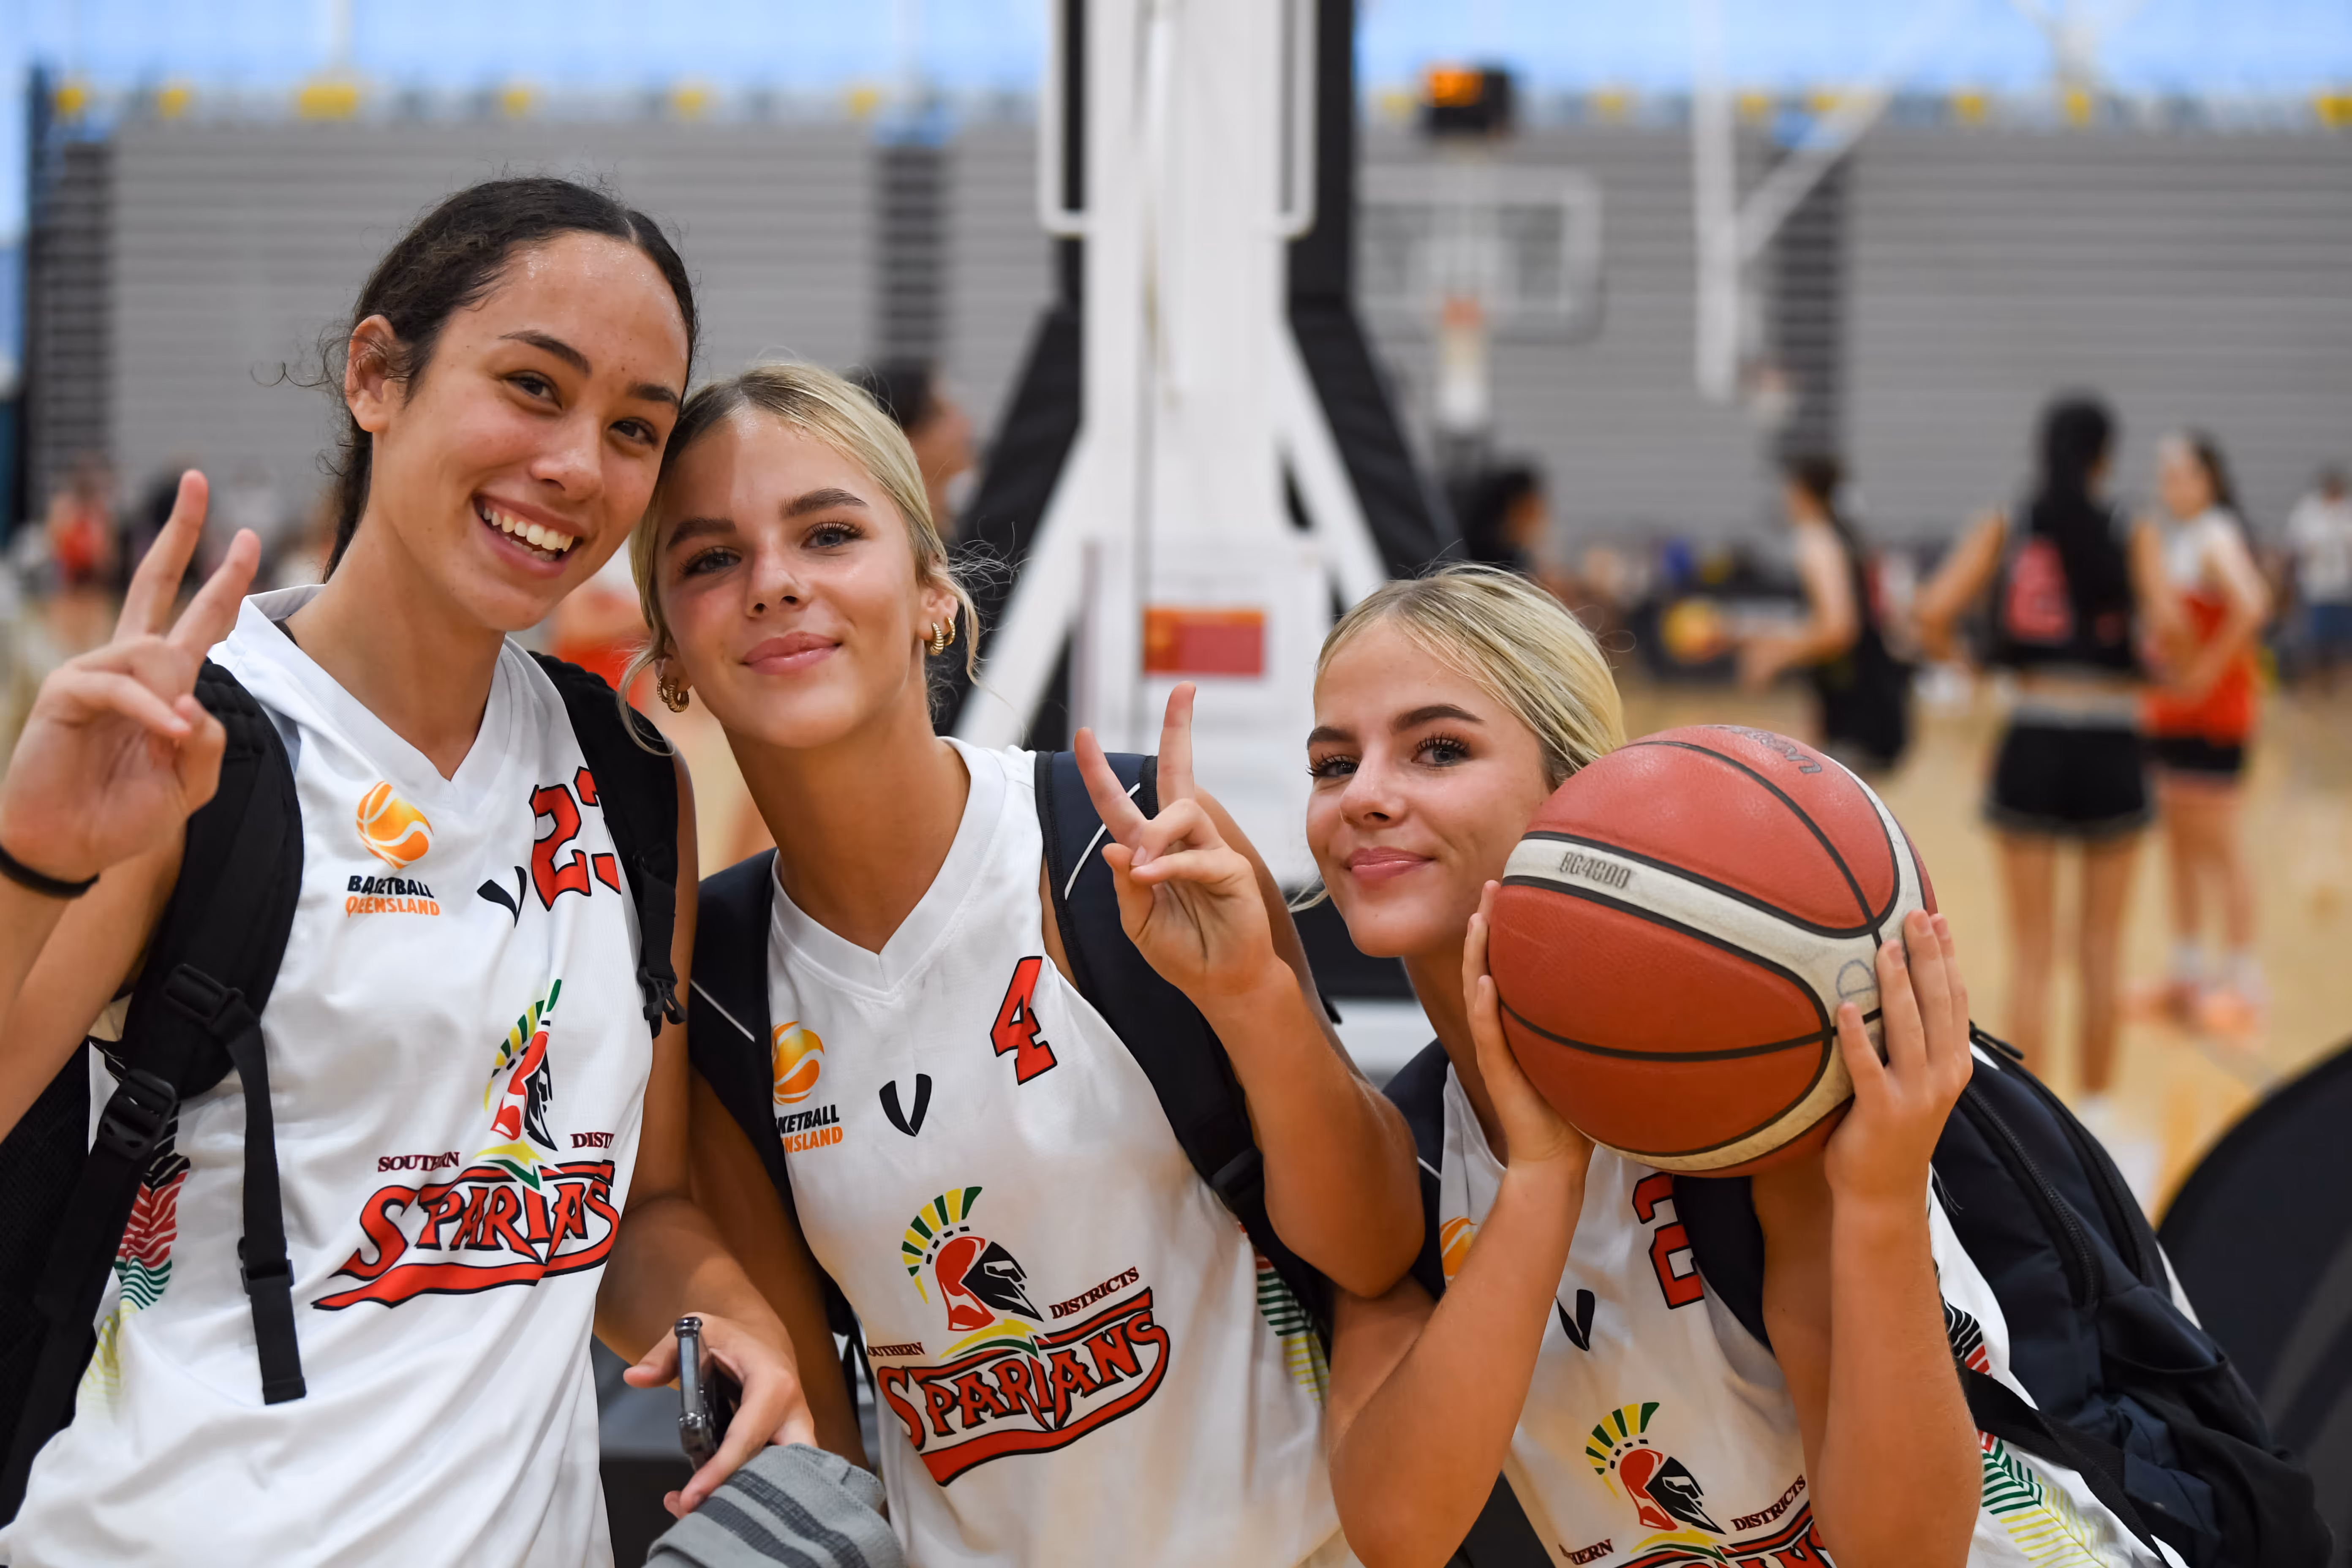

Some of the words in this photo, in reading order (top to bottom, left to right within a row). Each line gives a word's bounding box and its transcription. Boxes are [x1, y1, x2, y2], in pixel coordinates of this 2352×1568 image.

[990, 956, 1058, 1085] 4
[776, 1104, 840, 1134] KETBALL
[781, 1126, 843, 1154] NSLAND
[867, 1342, 925, 1357] OUTHERN
[1049, 1266, 1139, 1319] DISTRICTS
[877, 1311, 1170, 1486] SPARTANS
[1559, 1538, 1614, 1565] HERN
[1730, 1474, 1806, 1531] DISTRICTS
